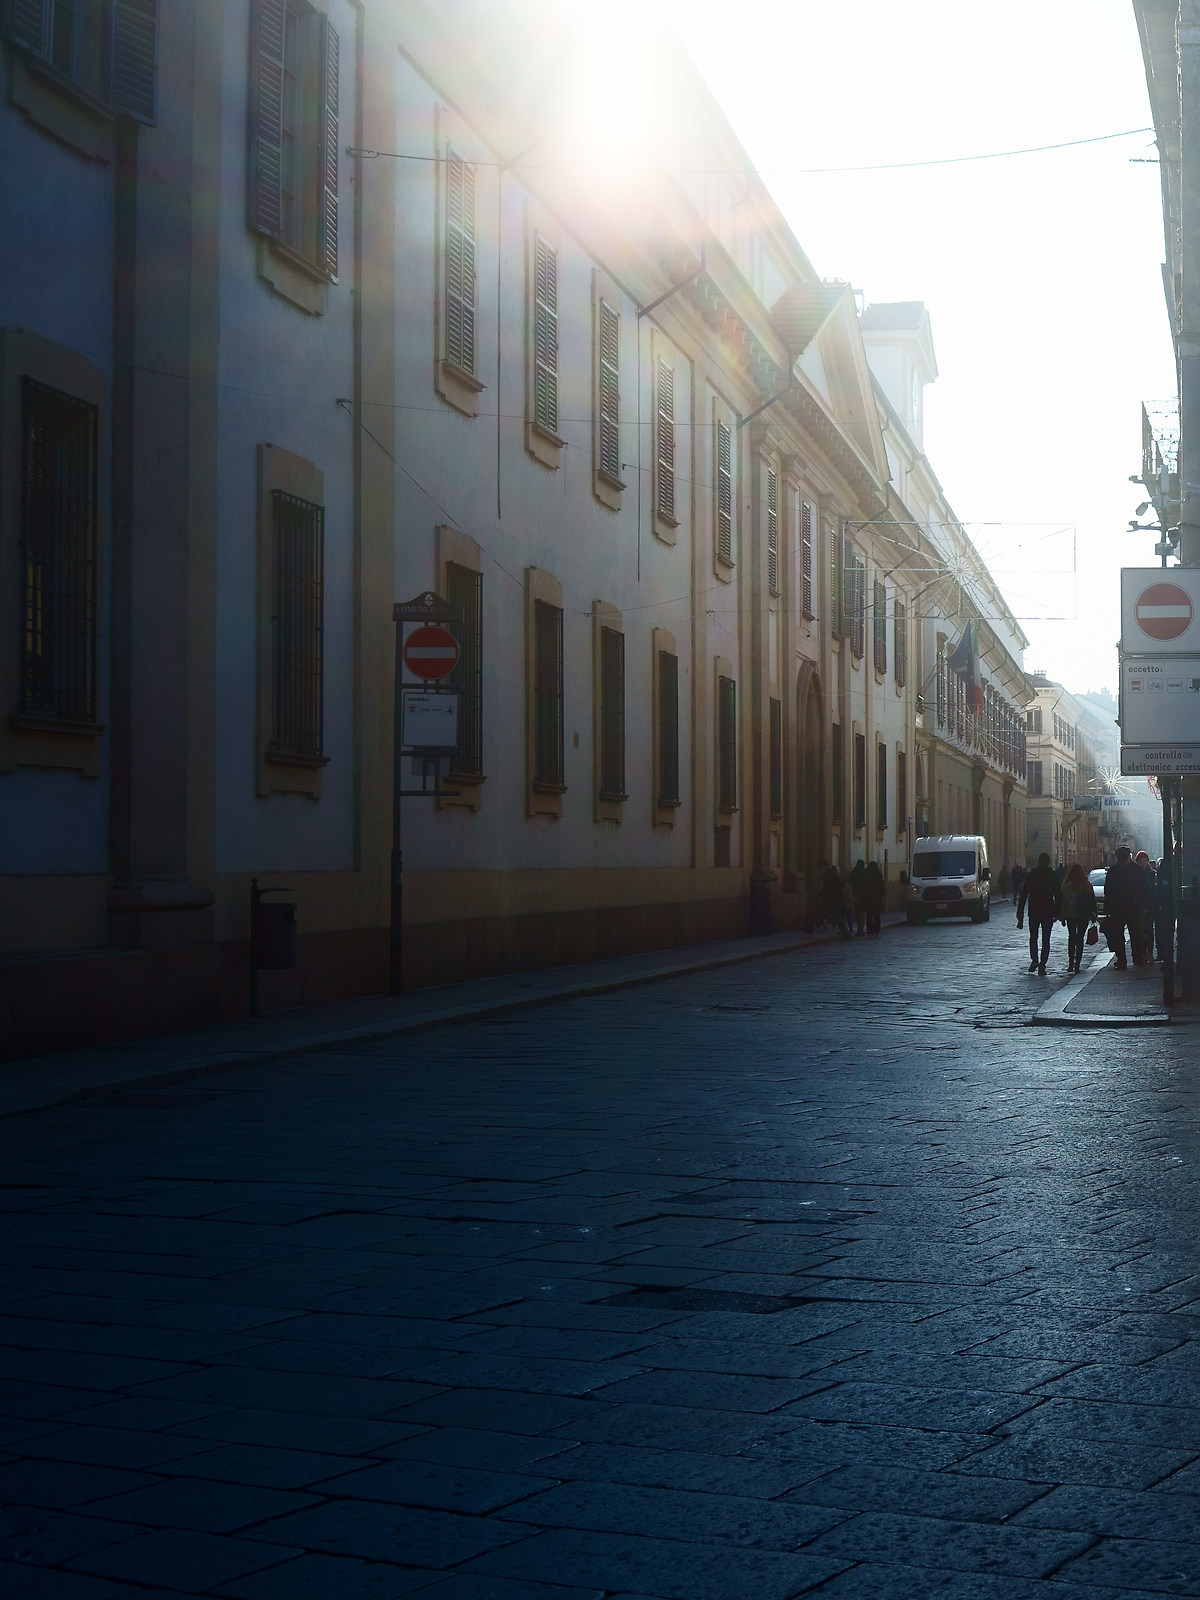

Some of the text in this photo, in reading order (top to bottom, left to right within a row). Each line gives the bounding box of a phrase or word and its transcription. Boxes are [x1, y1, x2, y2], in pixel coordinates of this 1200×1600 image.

[1128, 665, 1163, 673] eccetto:
[1145, 750, 1182, 759] controllo
[1127, 762, 1171, 771] elettronico
